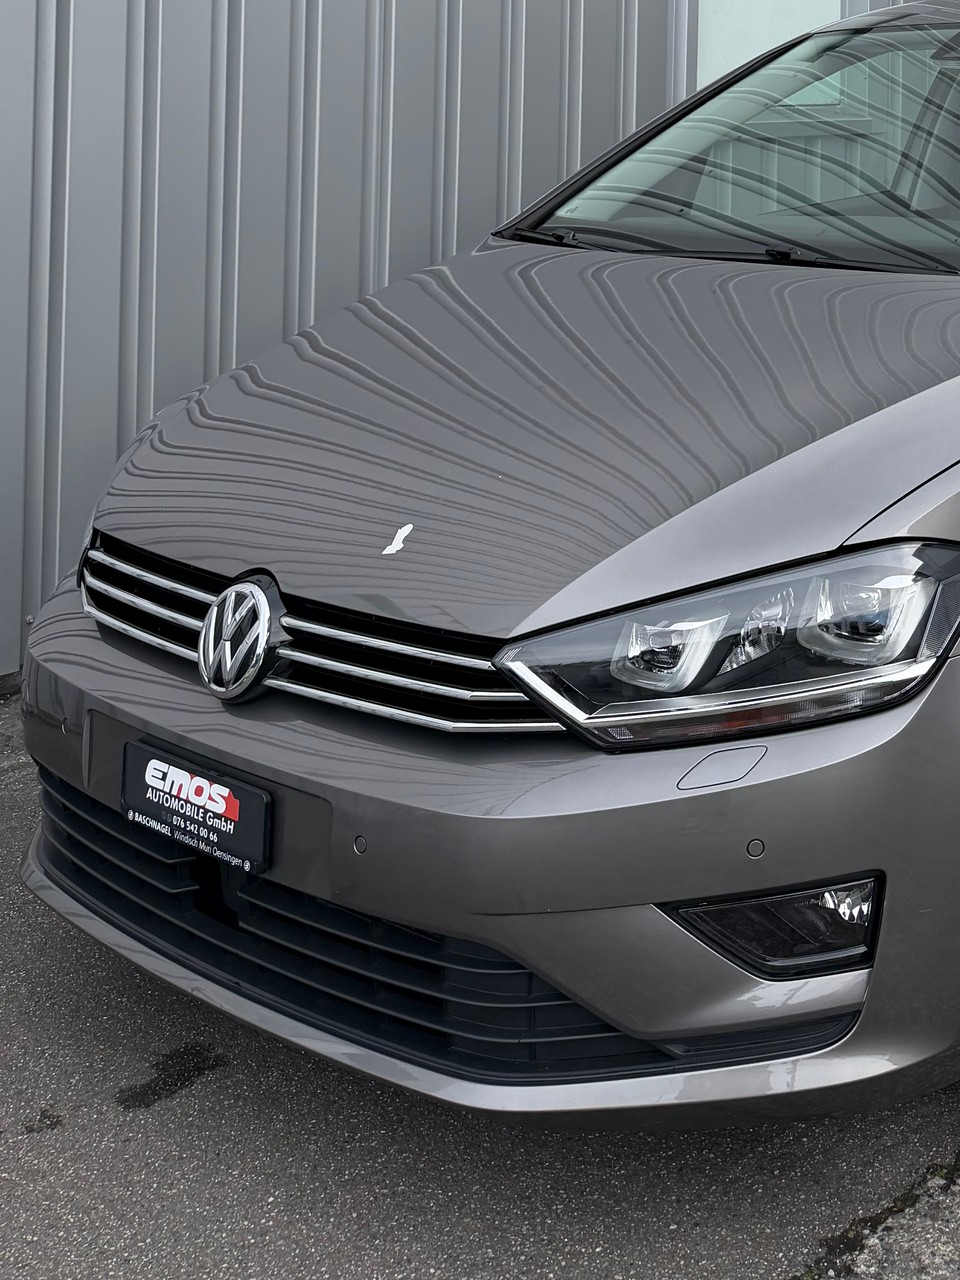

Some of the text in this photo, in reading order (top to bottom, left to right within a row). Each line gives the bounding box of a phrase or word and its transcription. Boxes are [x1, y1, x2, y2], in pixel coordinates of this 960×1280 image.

[145, 758, 230, 814] EMOS
[146, 787, 235, 835] AUTOMOBILE GmbH
[134, 812, 172, 837] BASCHNAGEL
[173, 829, 199, 848] Windisch
[212, 846, 243, 867] Oensingen
[172, 815, 218, 843] 076 542 00 66
